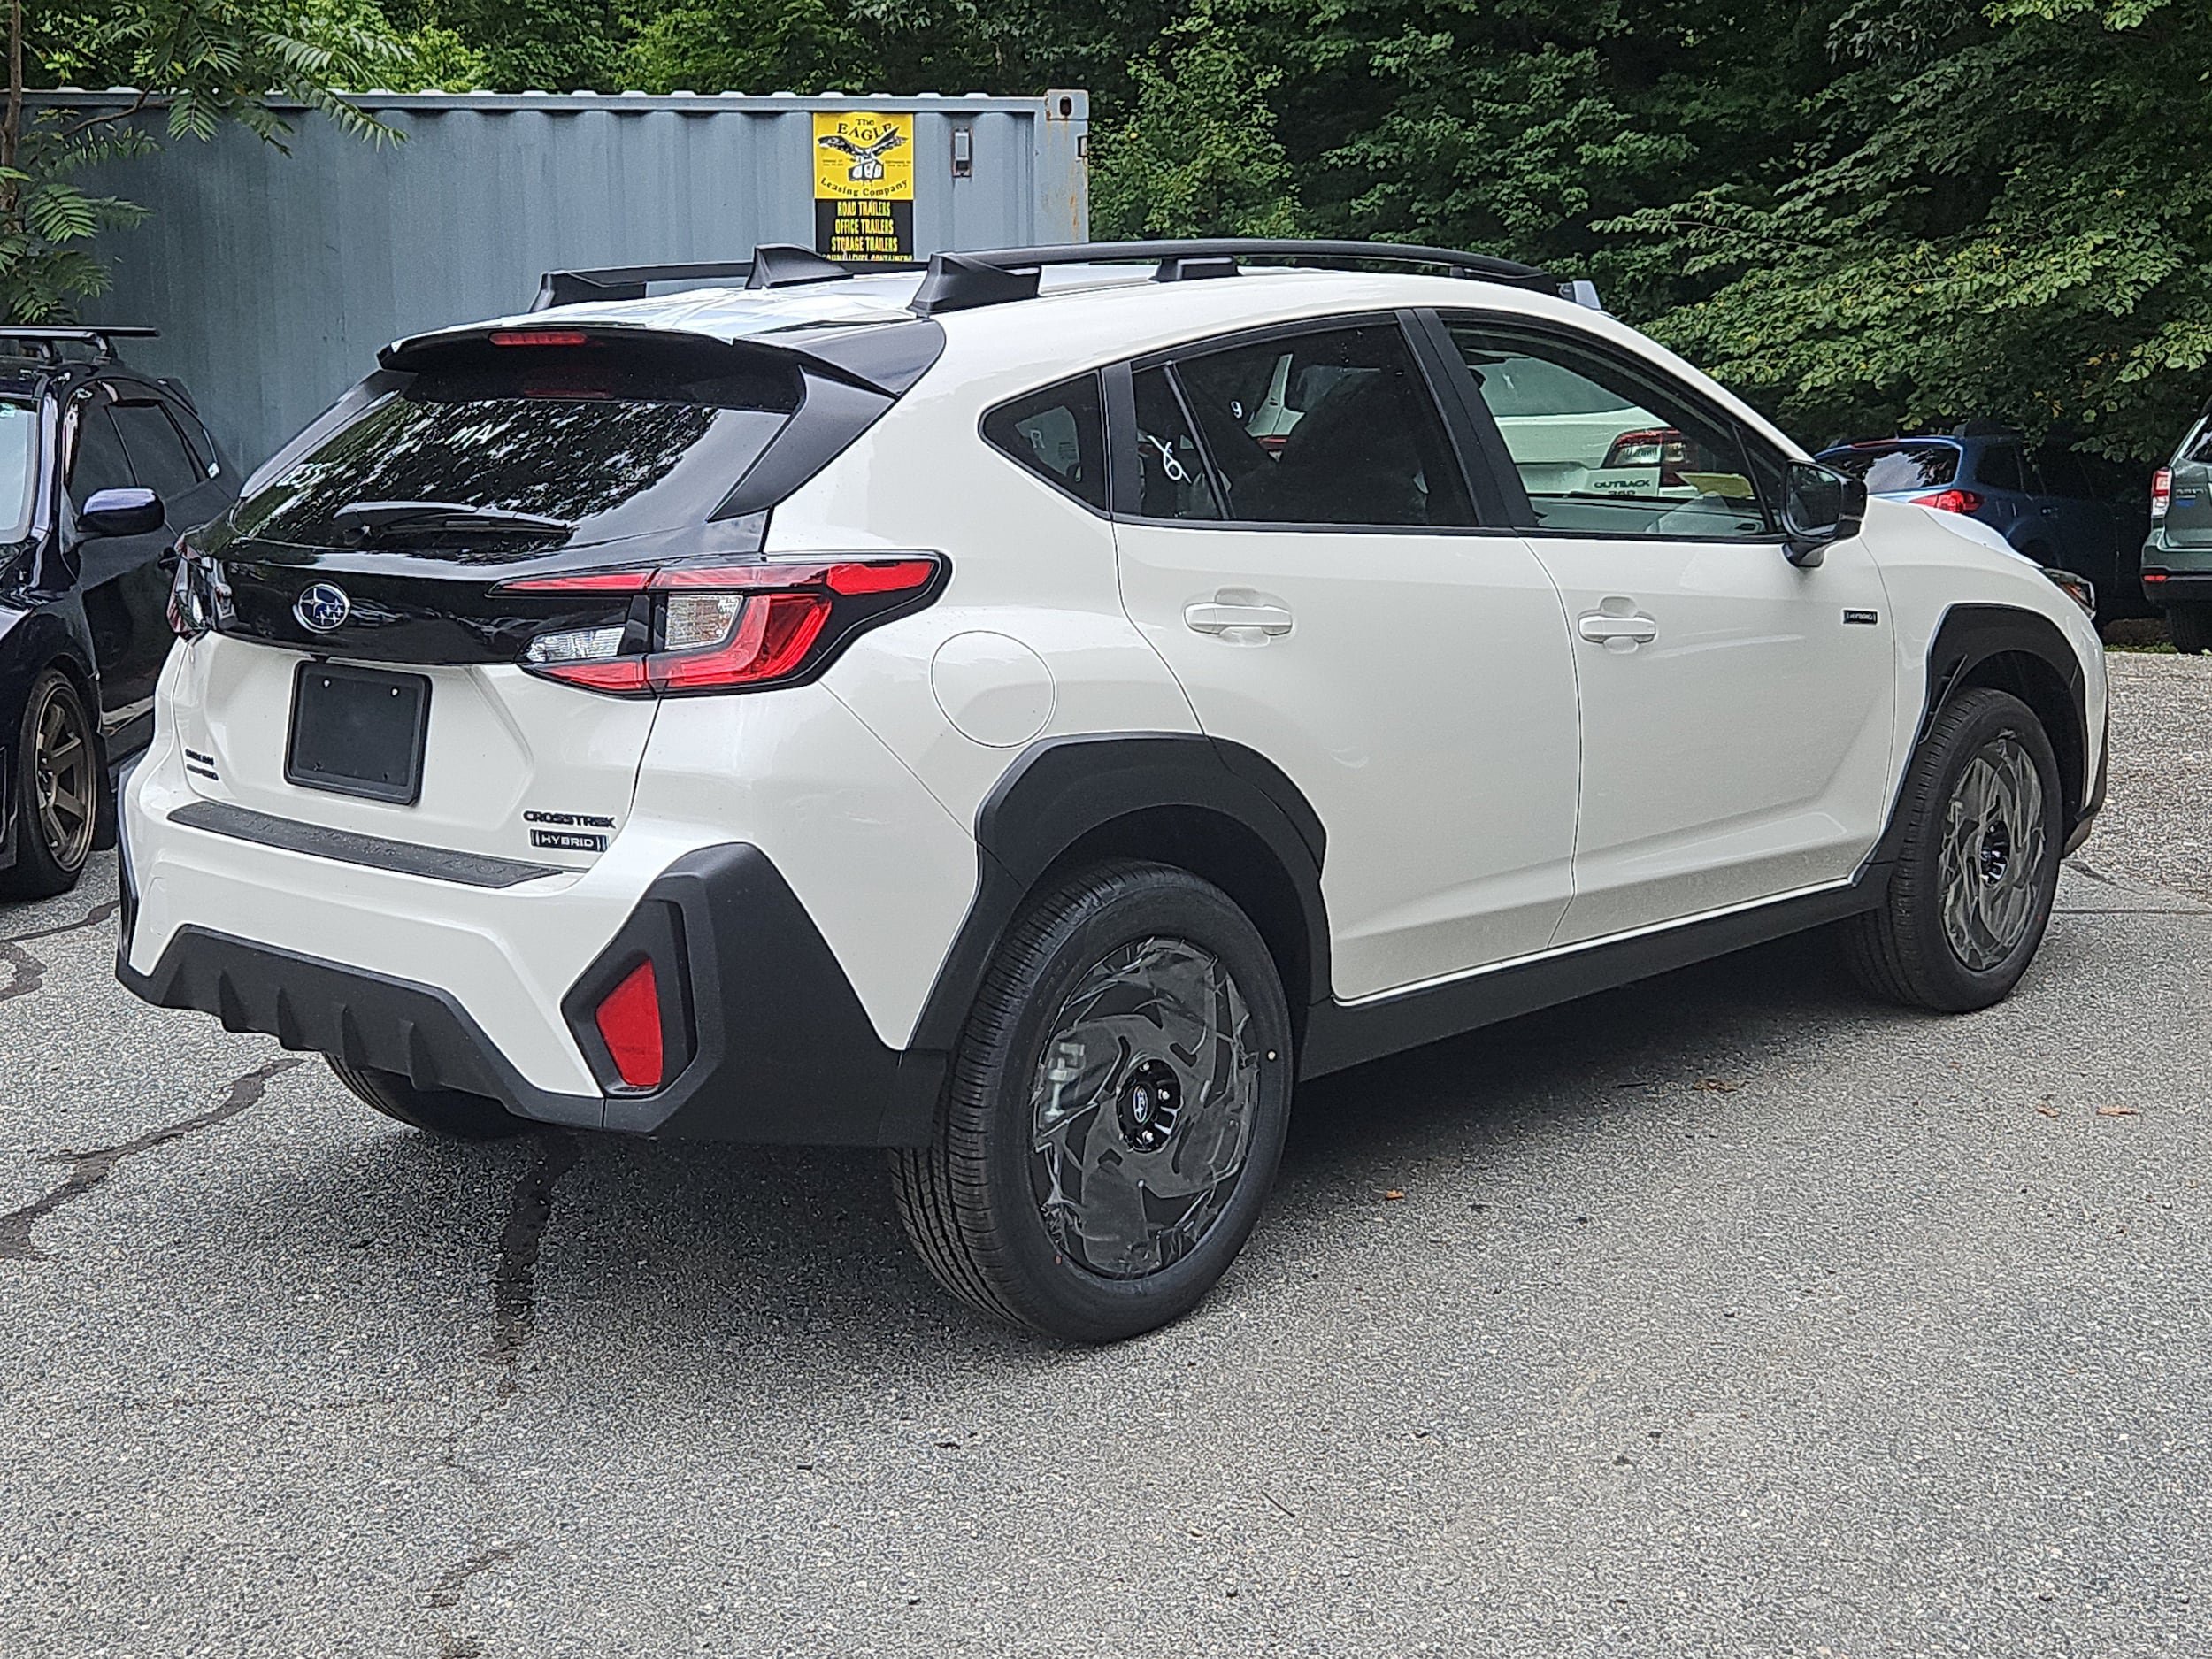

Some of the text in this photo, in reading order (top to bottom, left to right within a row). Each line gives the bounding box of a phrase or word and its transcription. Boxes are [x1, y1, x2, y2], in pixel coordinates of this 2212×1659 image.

[837, 123, 892, 141] EAGLE
[820, 177, 908, 196] Leasing Company
[837, 201, 891, 217] ROAD TRAILERS
[835, 219, 894, 234] OFFICE TRAILERS
[831, 236, 898, 252] STORAGE TRAILERS
[523, 810, 617, 829] CROSSTREK
[541, 834, 594, 847] HYBRID
